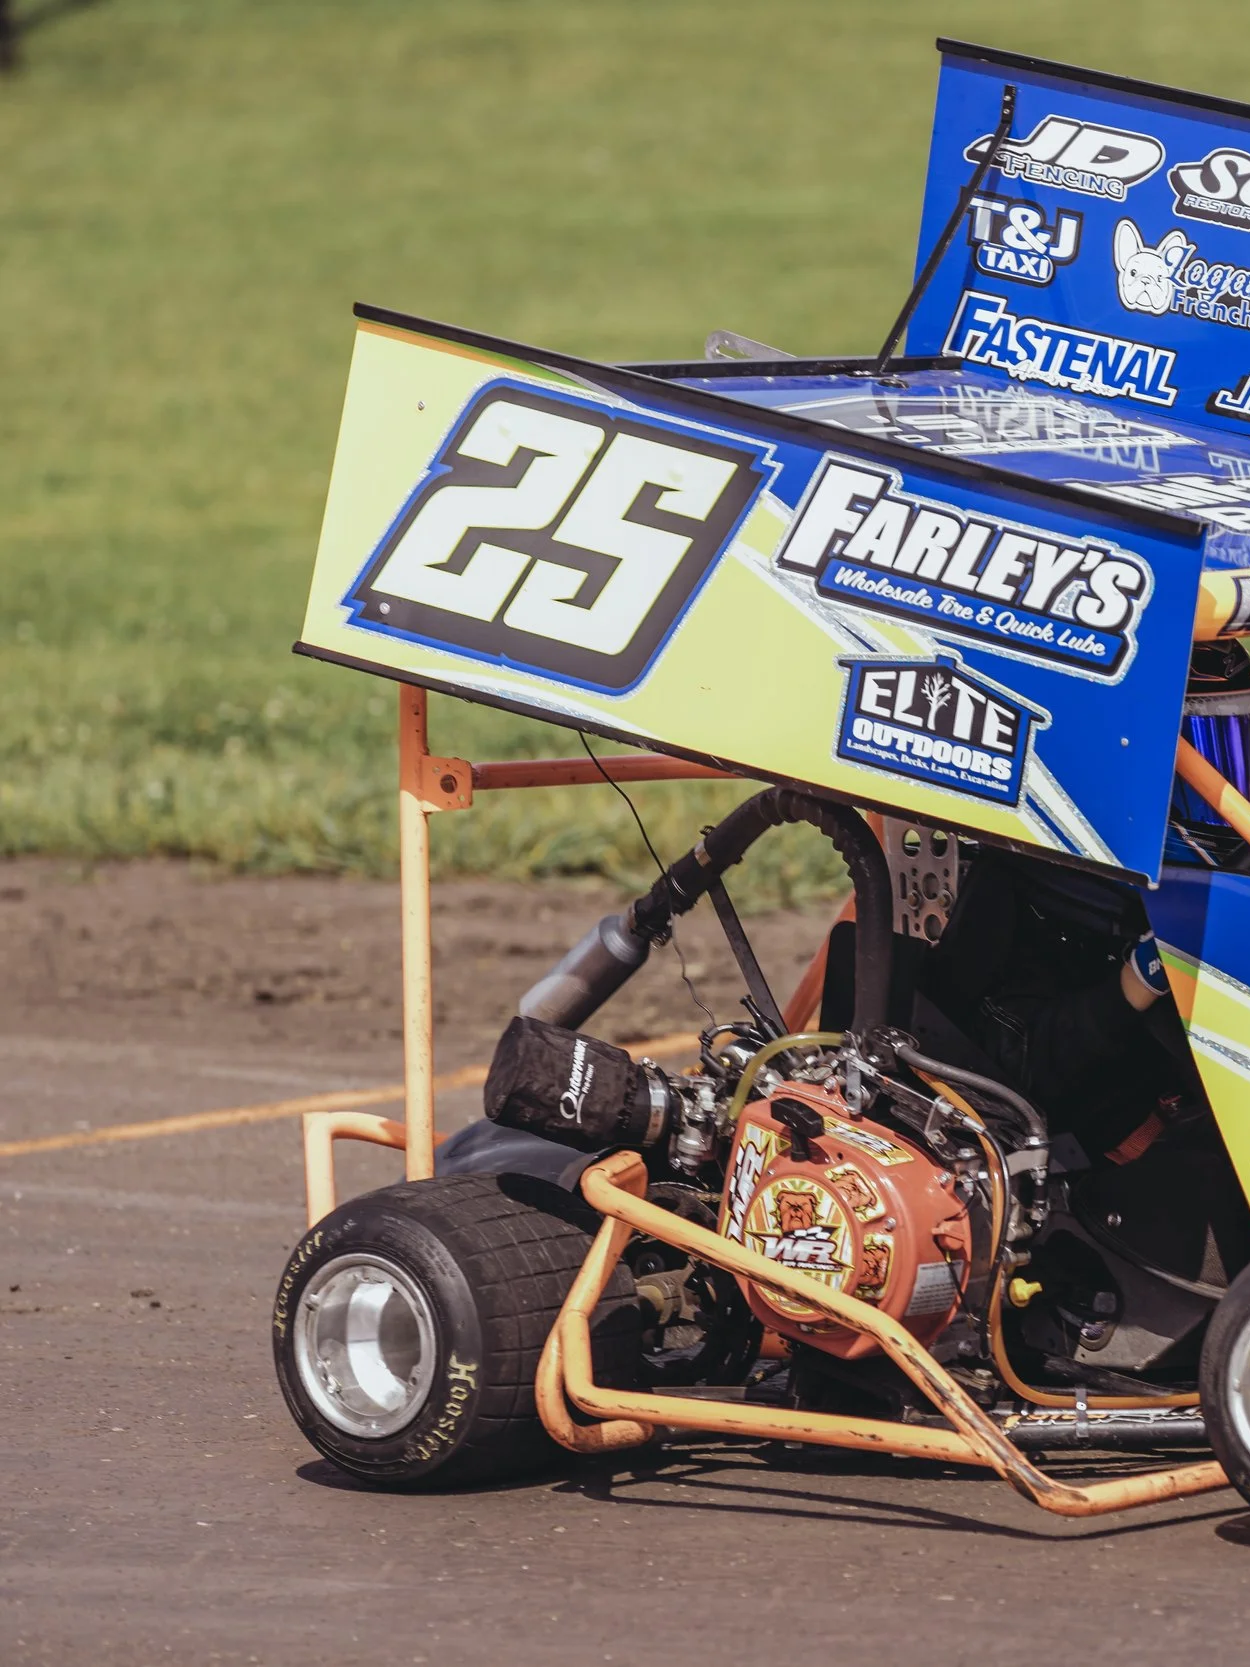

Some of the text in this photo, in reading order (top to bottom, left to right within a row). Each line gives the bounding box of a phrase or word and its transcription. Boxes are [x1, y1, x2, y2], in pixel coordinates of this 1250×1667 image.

[974, 119, 1163, 179] JD
[995, 152, 1124, 198] FENCING
[970, 197, 1079, 258] T&J
[982, 246, 1050, 279] TAXI
[946, 293, 1176, 404] FASTENAL
[370, 399, 740, 657] 25
[783, 463, 1142, 628] FARLEY'S
[834, 565, 1107, 657] Wholesale Tire & Quick Lube
[852, 717, 1013, 782] OUTDOORS
